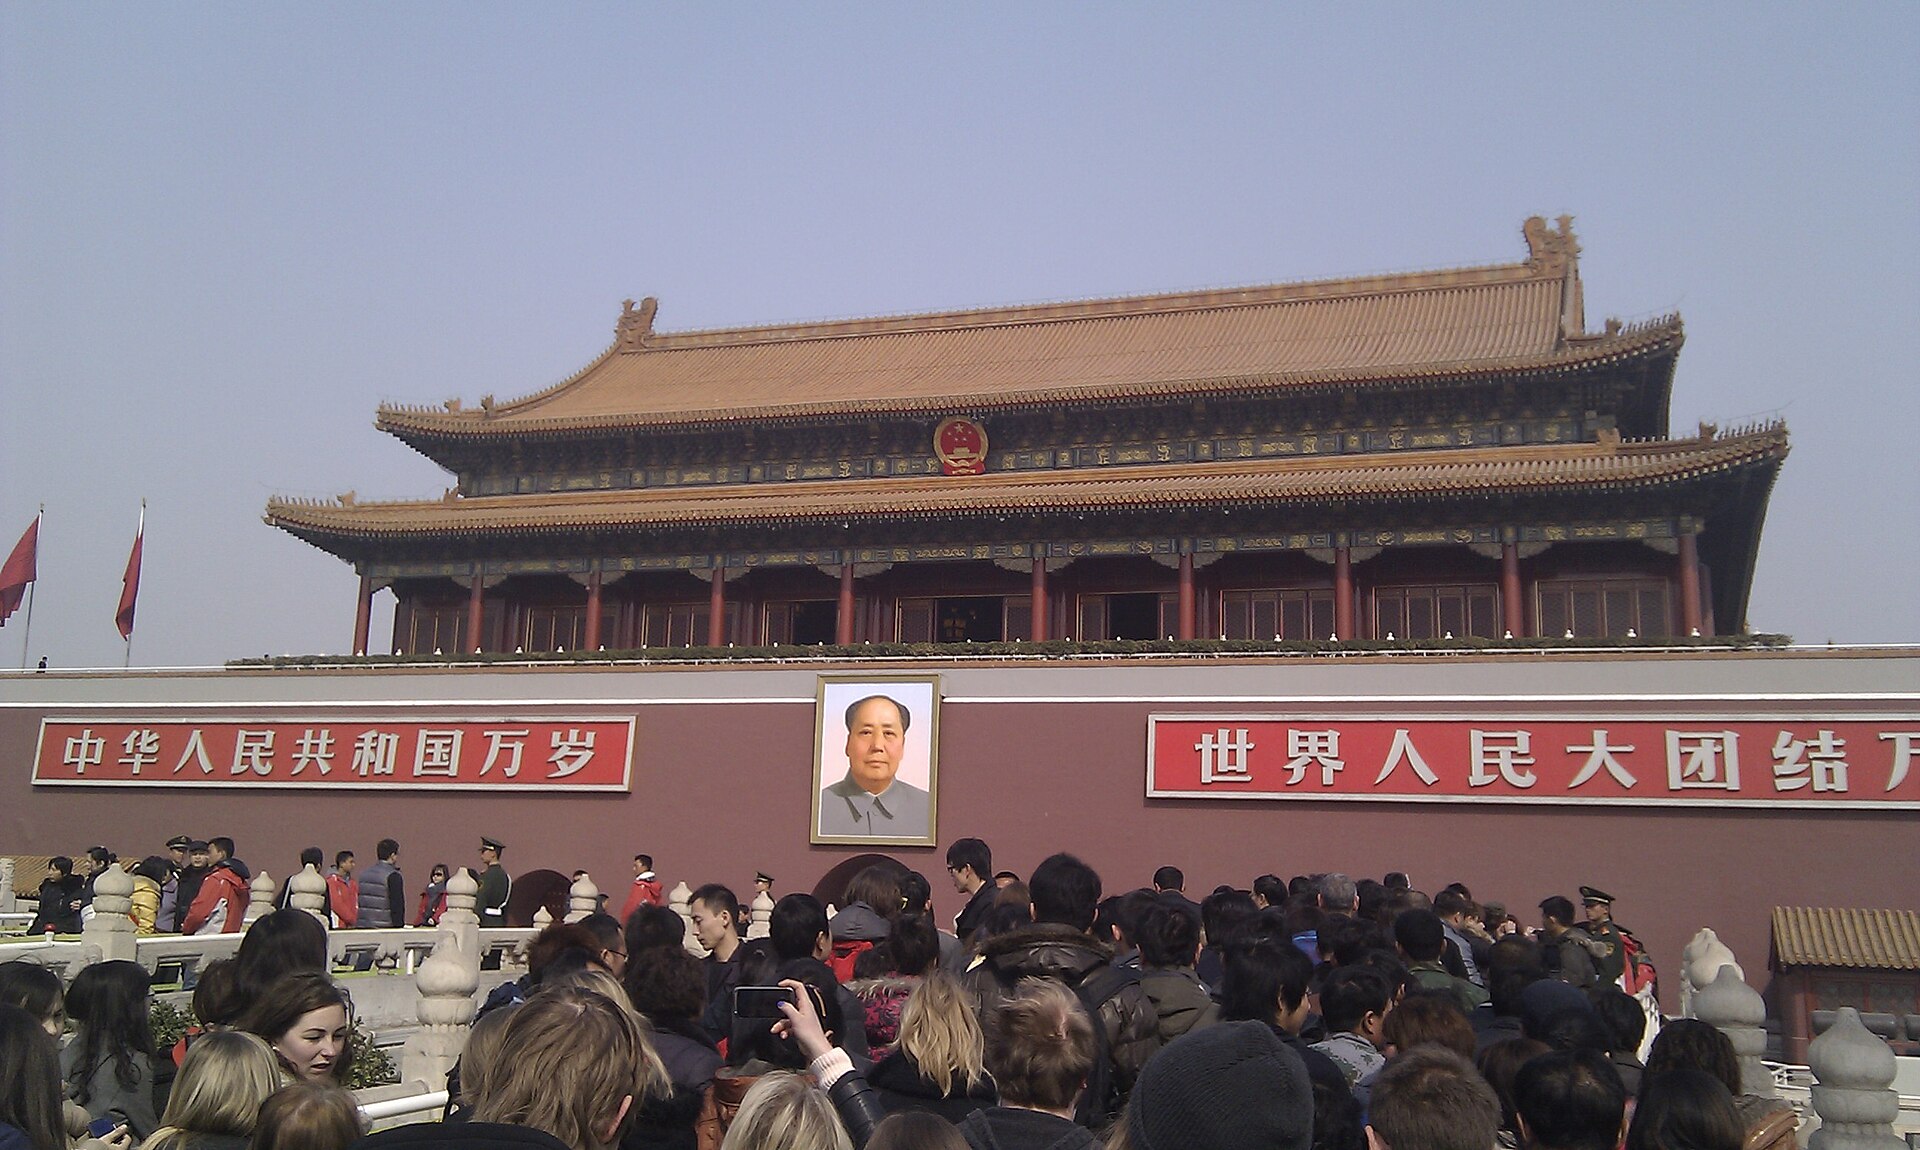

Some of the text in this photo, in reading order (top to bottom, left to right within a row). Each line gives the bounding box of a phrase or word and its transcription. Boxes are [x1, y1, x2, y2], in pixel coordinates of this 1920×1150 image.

[63, 729, 596, 779] 中华人民共和国万岁
